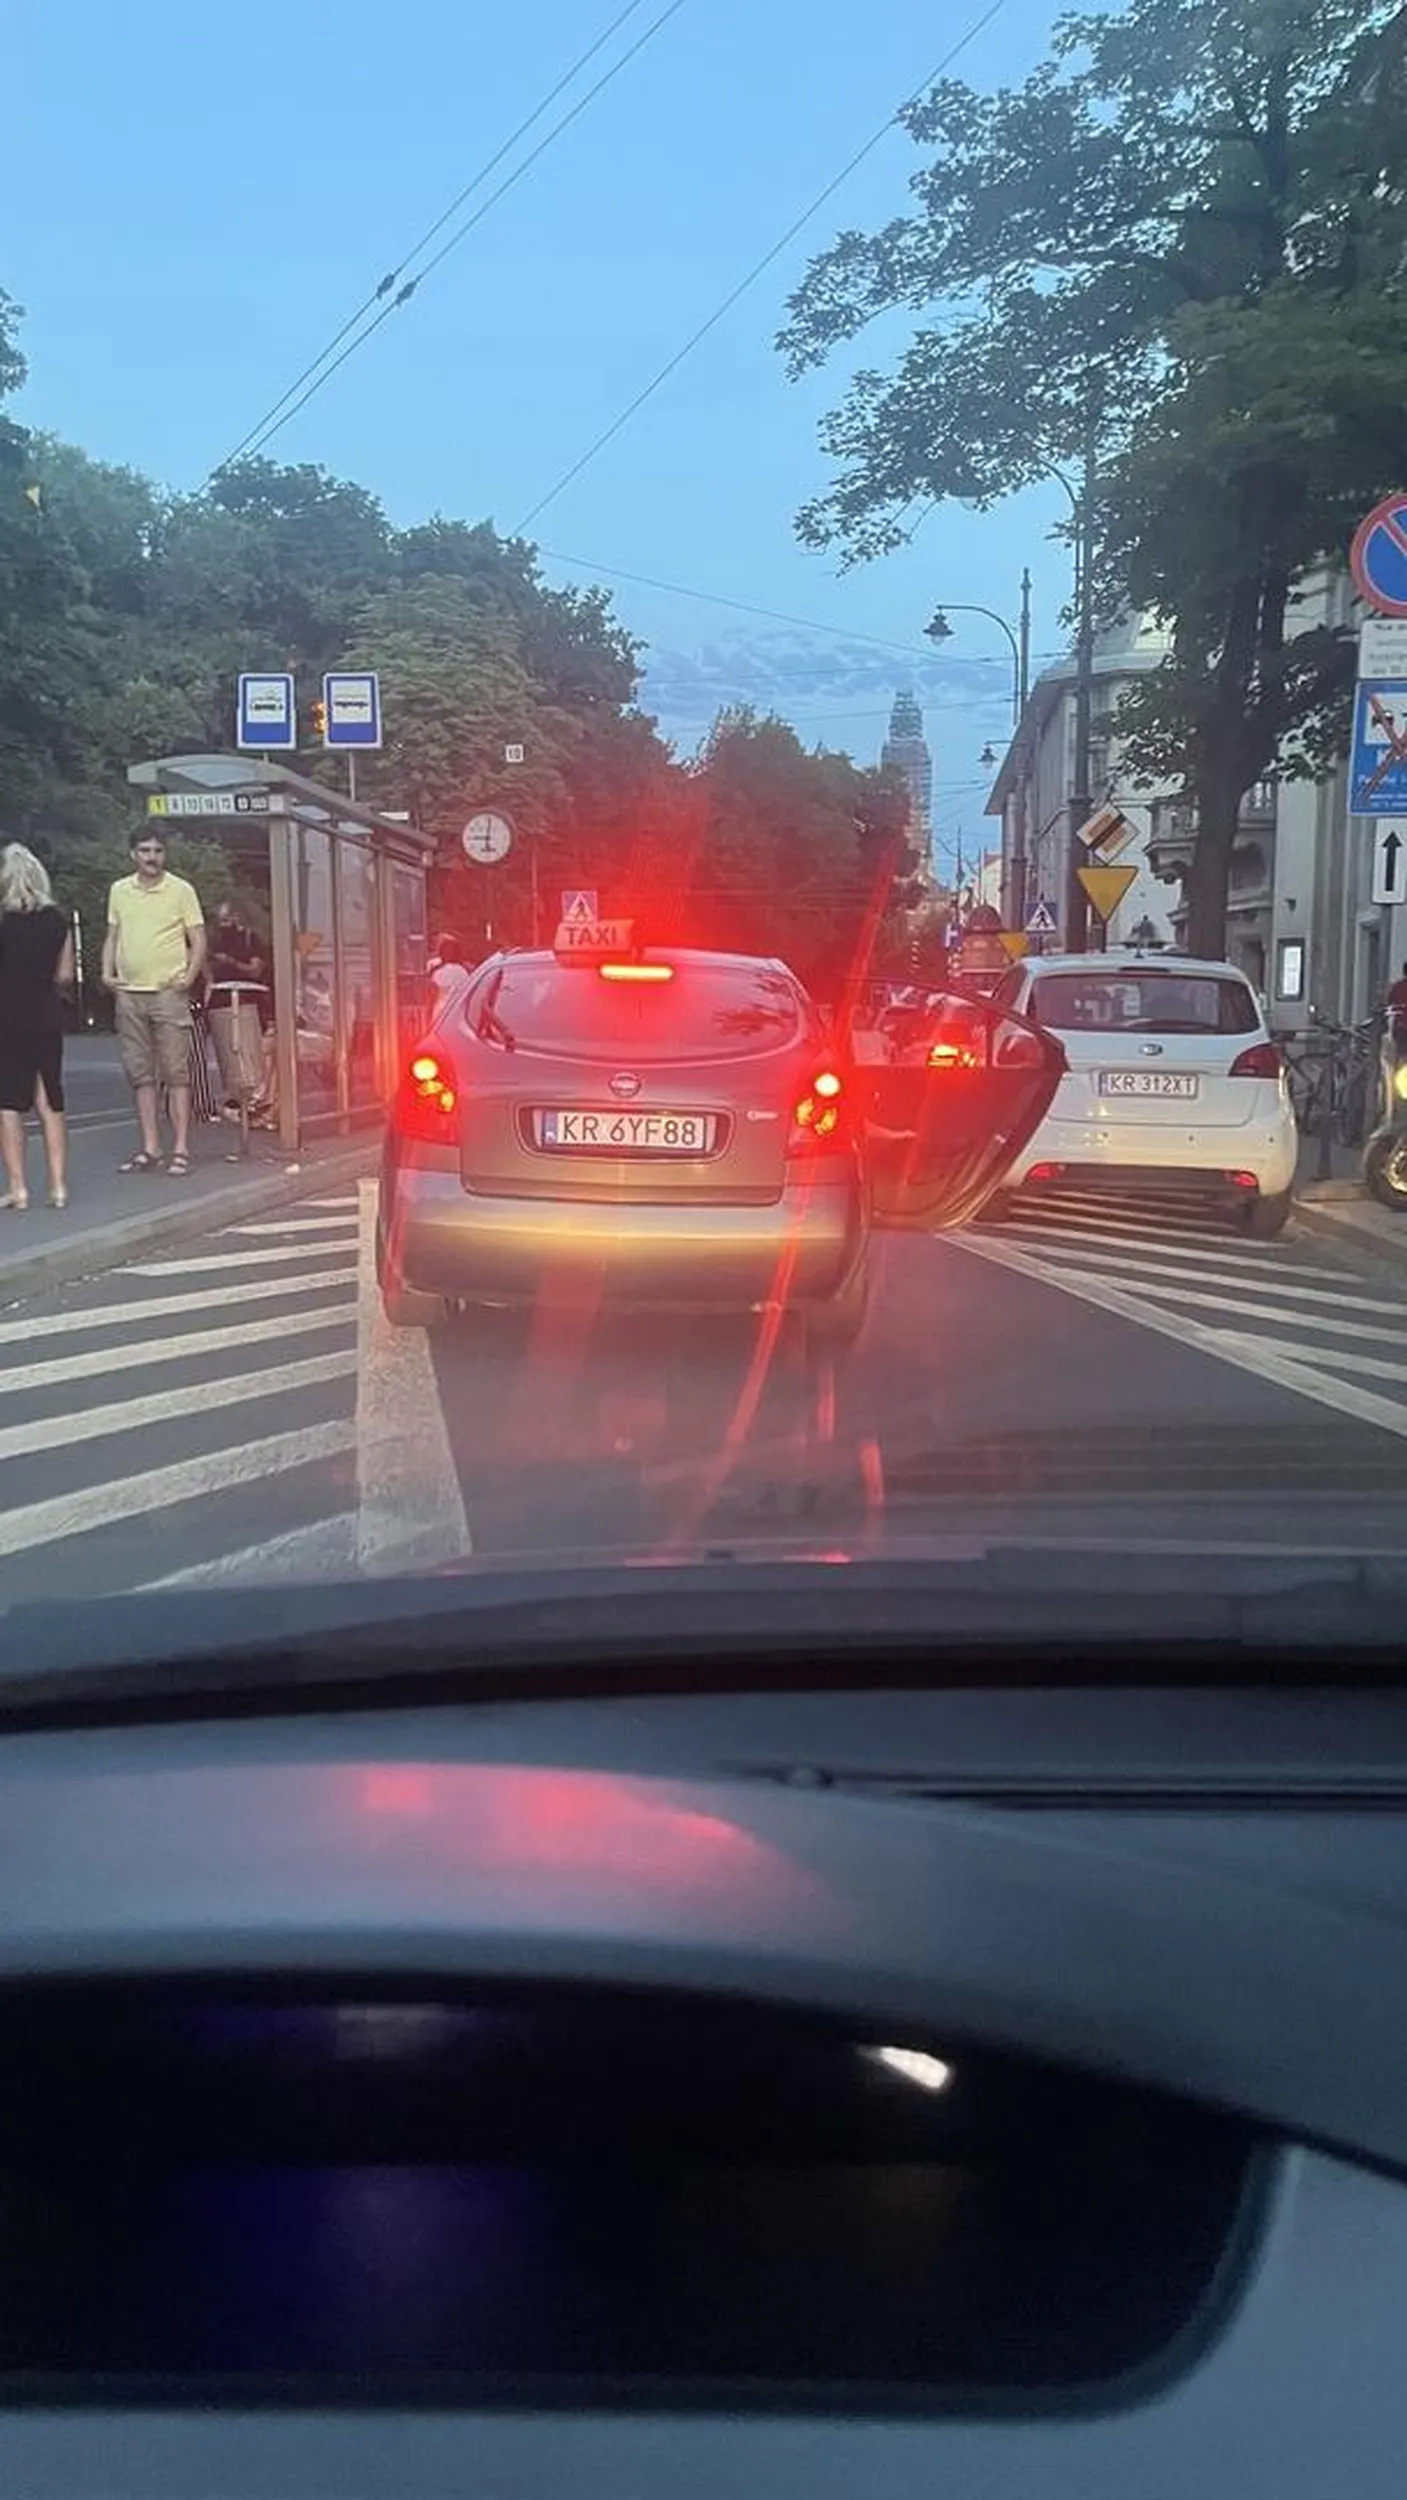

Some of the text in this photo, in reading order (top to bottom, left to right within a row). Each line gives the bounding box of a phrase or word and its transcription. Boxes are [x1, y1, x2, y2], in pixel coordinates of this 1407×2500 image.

[564, 926, 618, 945] TAXI
[1110, 1075, 1135, 1092] KR
[563, 1115, 696, 1146] KR 6YF88
